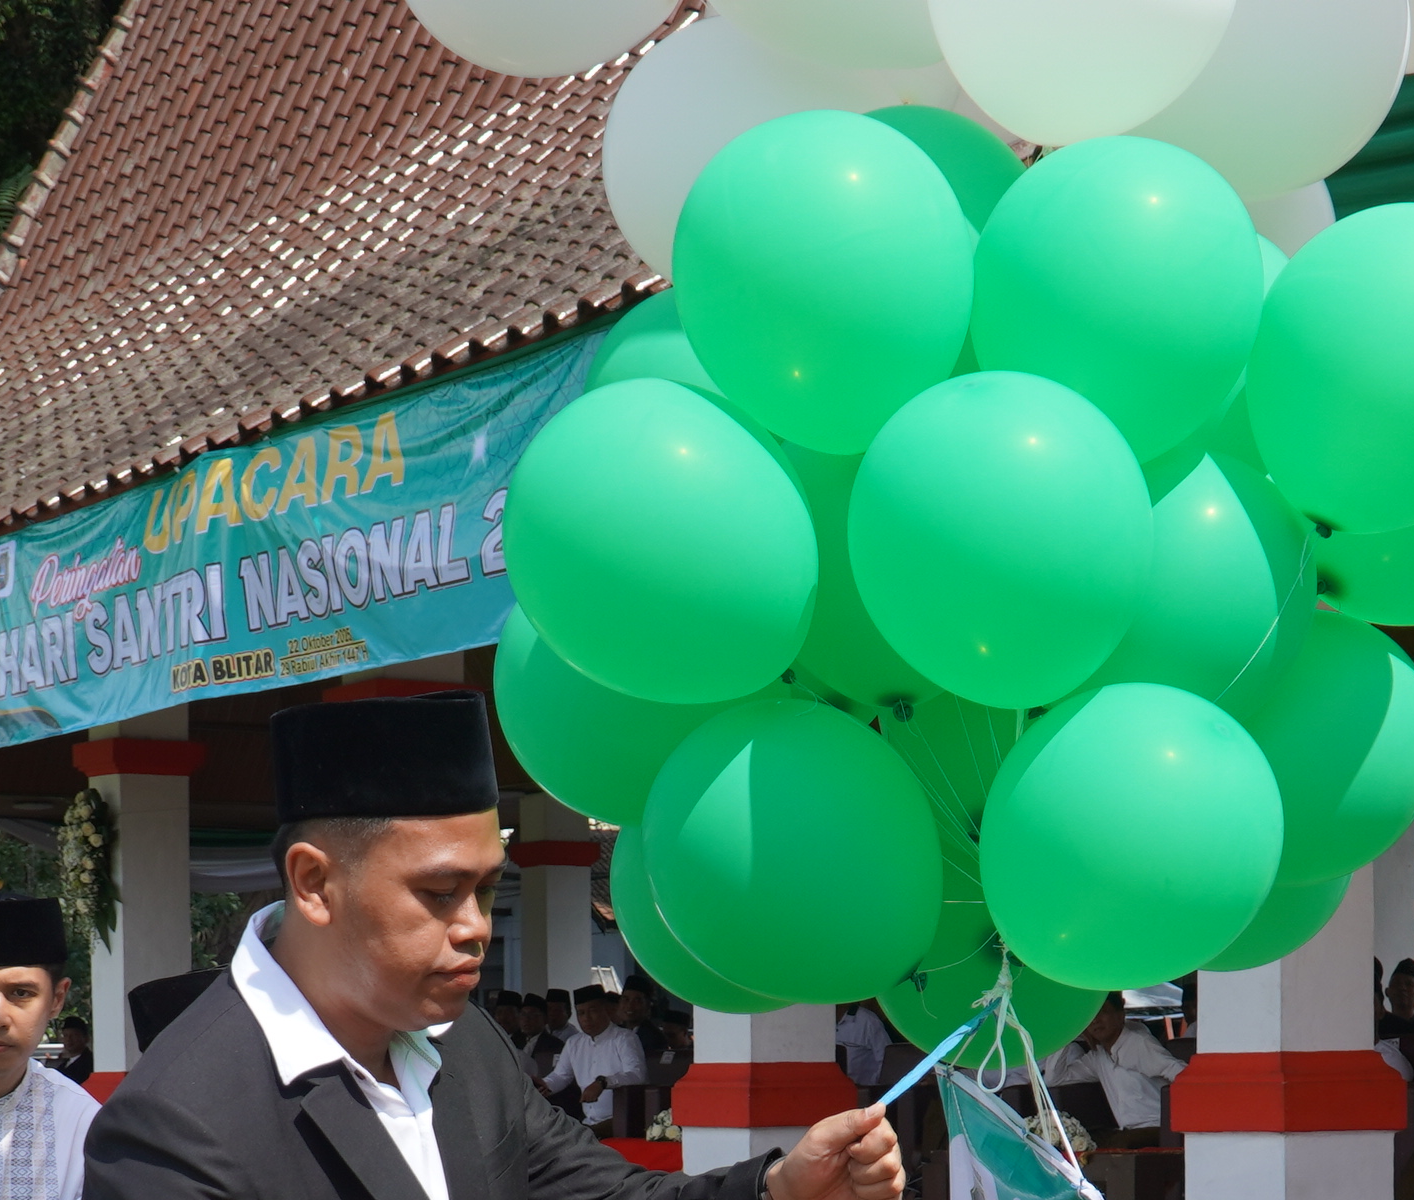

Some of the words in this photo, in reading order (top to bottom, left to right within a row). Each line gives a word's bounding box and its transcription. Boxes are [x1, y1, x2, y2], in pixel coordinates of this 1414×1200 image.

[143, 411, 405, 554] UPACARA
[30, 536, 142, 621] Peringatan
[87, 562, 228, 677] SANTRI
[239, 502, 473, 634] NASIONAL
[172, 659, 208, 692] KOTA
[212, 650, 274, 682] BLITAR
[288, 639, 300, 654] 22
[301, 632, 334, 652] Oktober
